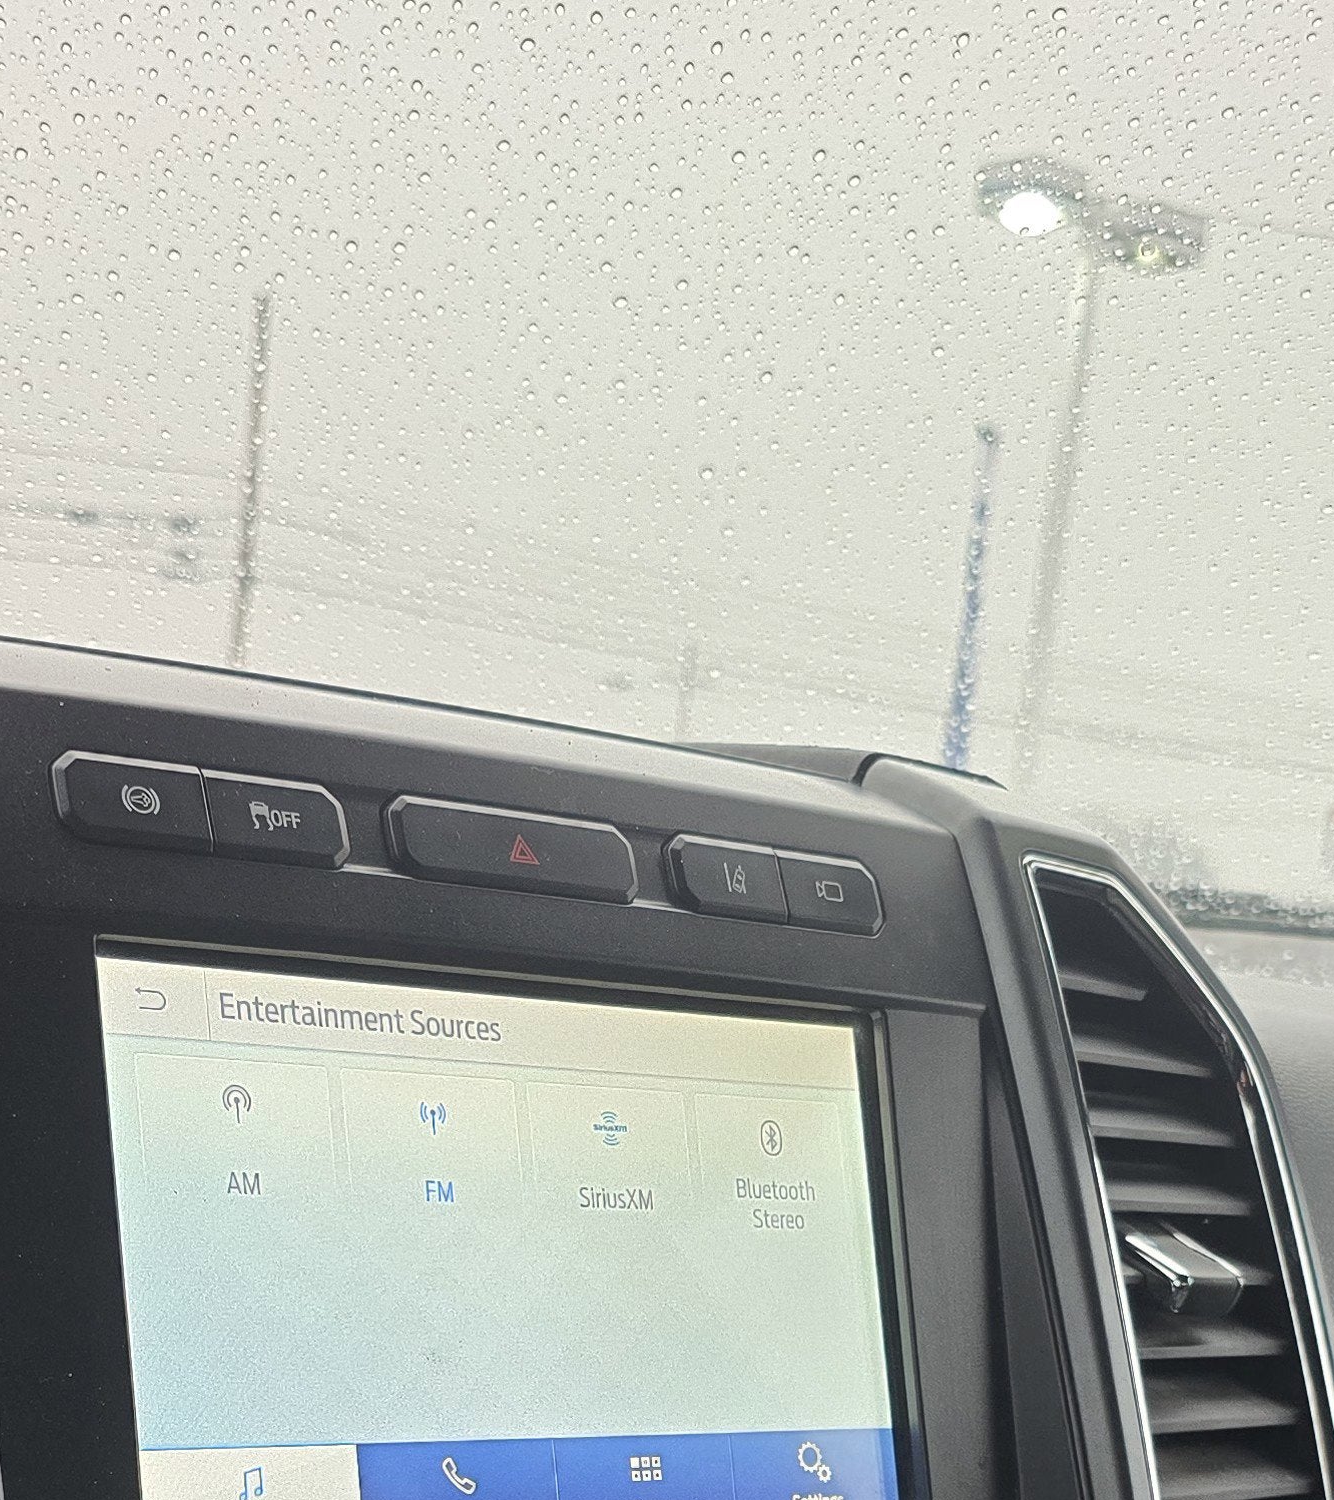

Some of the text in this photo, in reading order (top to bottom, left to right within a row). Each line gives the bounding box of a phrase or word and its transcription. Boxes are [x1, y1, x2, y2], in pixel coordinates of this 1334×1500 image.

[271, 808, 301, 830] OFF
[219, 992, 502, 1044] Entertainment Sources
[227, 1173, 261, 1197] AM
[425, 1180, 455, 1204] FM
[735, 1178, 816, 1202] Bluetooth
[579, 1186, 654, 1213] SiriusXM
[752, 1207, 805, 1231] Stereo
